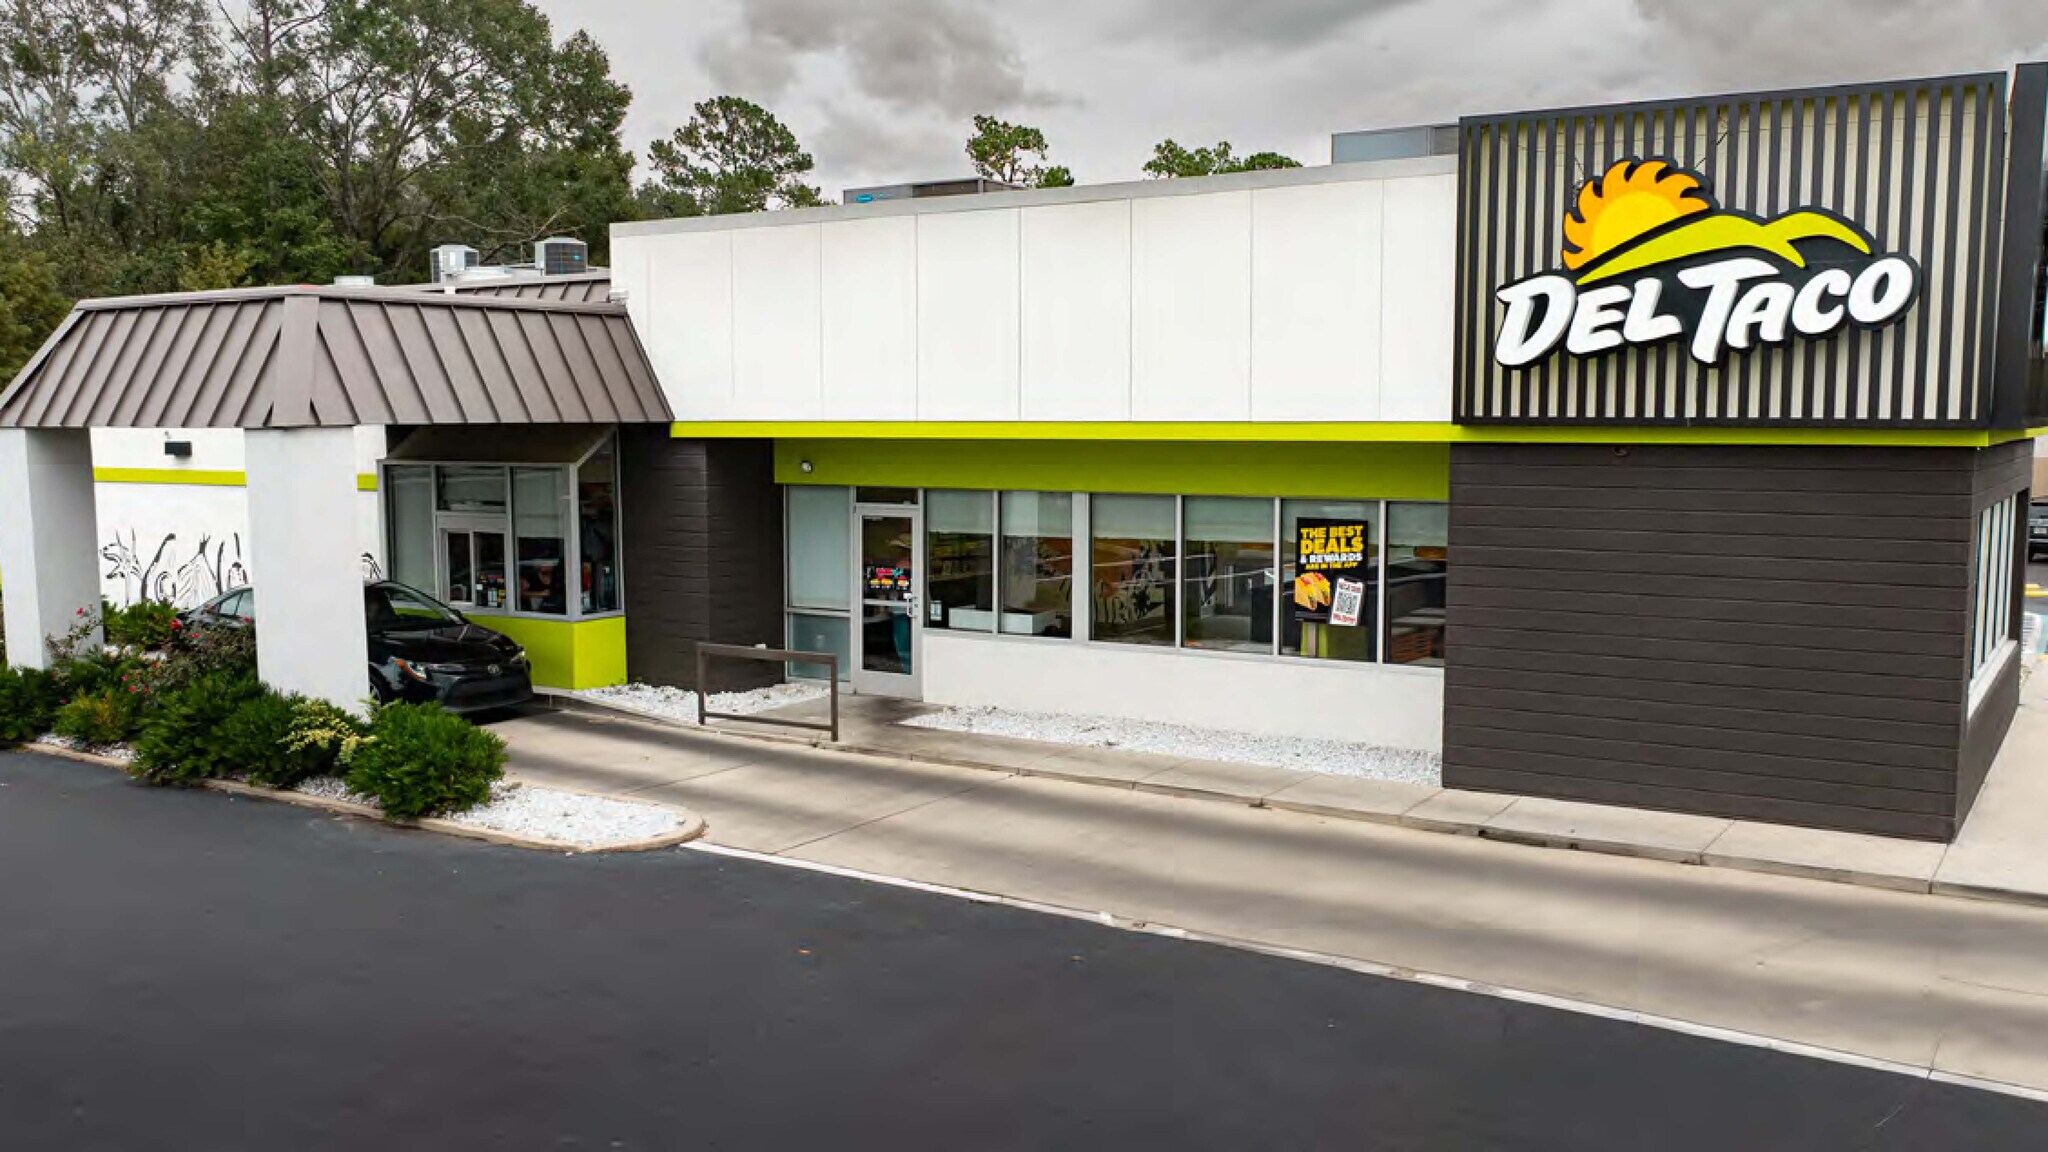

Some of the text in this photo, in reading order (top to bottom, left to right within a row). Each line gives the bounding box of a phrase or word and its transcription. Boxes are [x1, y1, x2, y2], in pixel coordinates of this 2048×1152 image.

[1495, 257, 1914, 367] DEL TACO
[1300, 525, 1364, 538] THE BEST
[1300, 537, 1364, 554] DEALS
[1309, 552, 1363, 563] REWARDS
